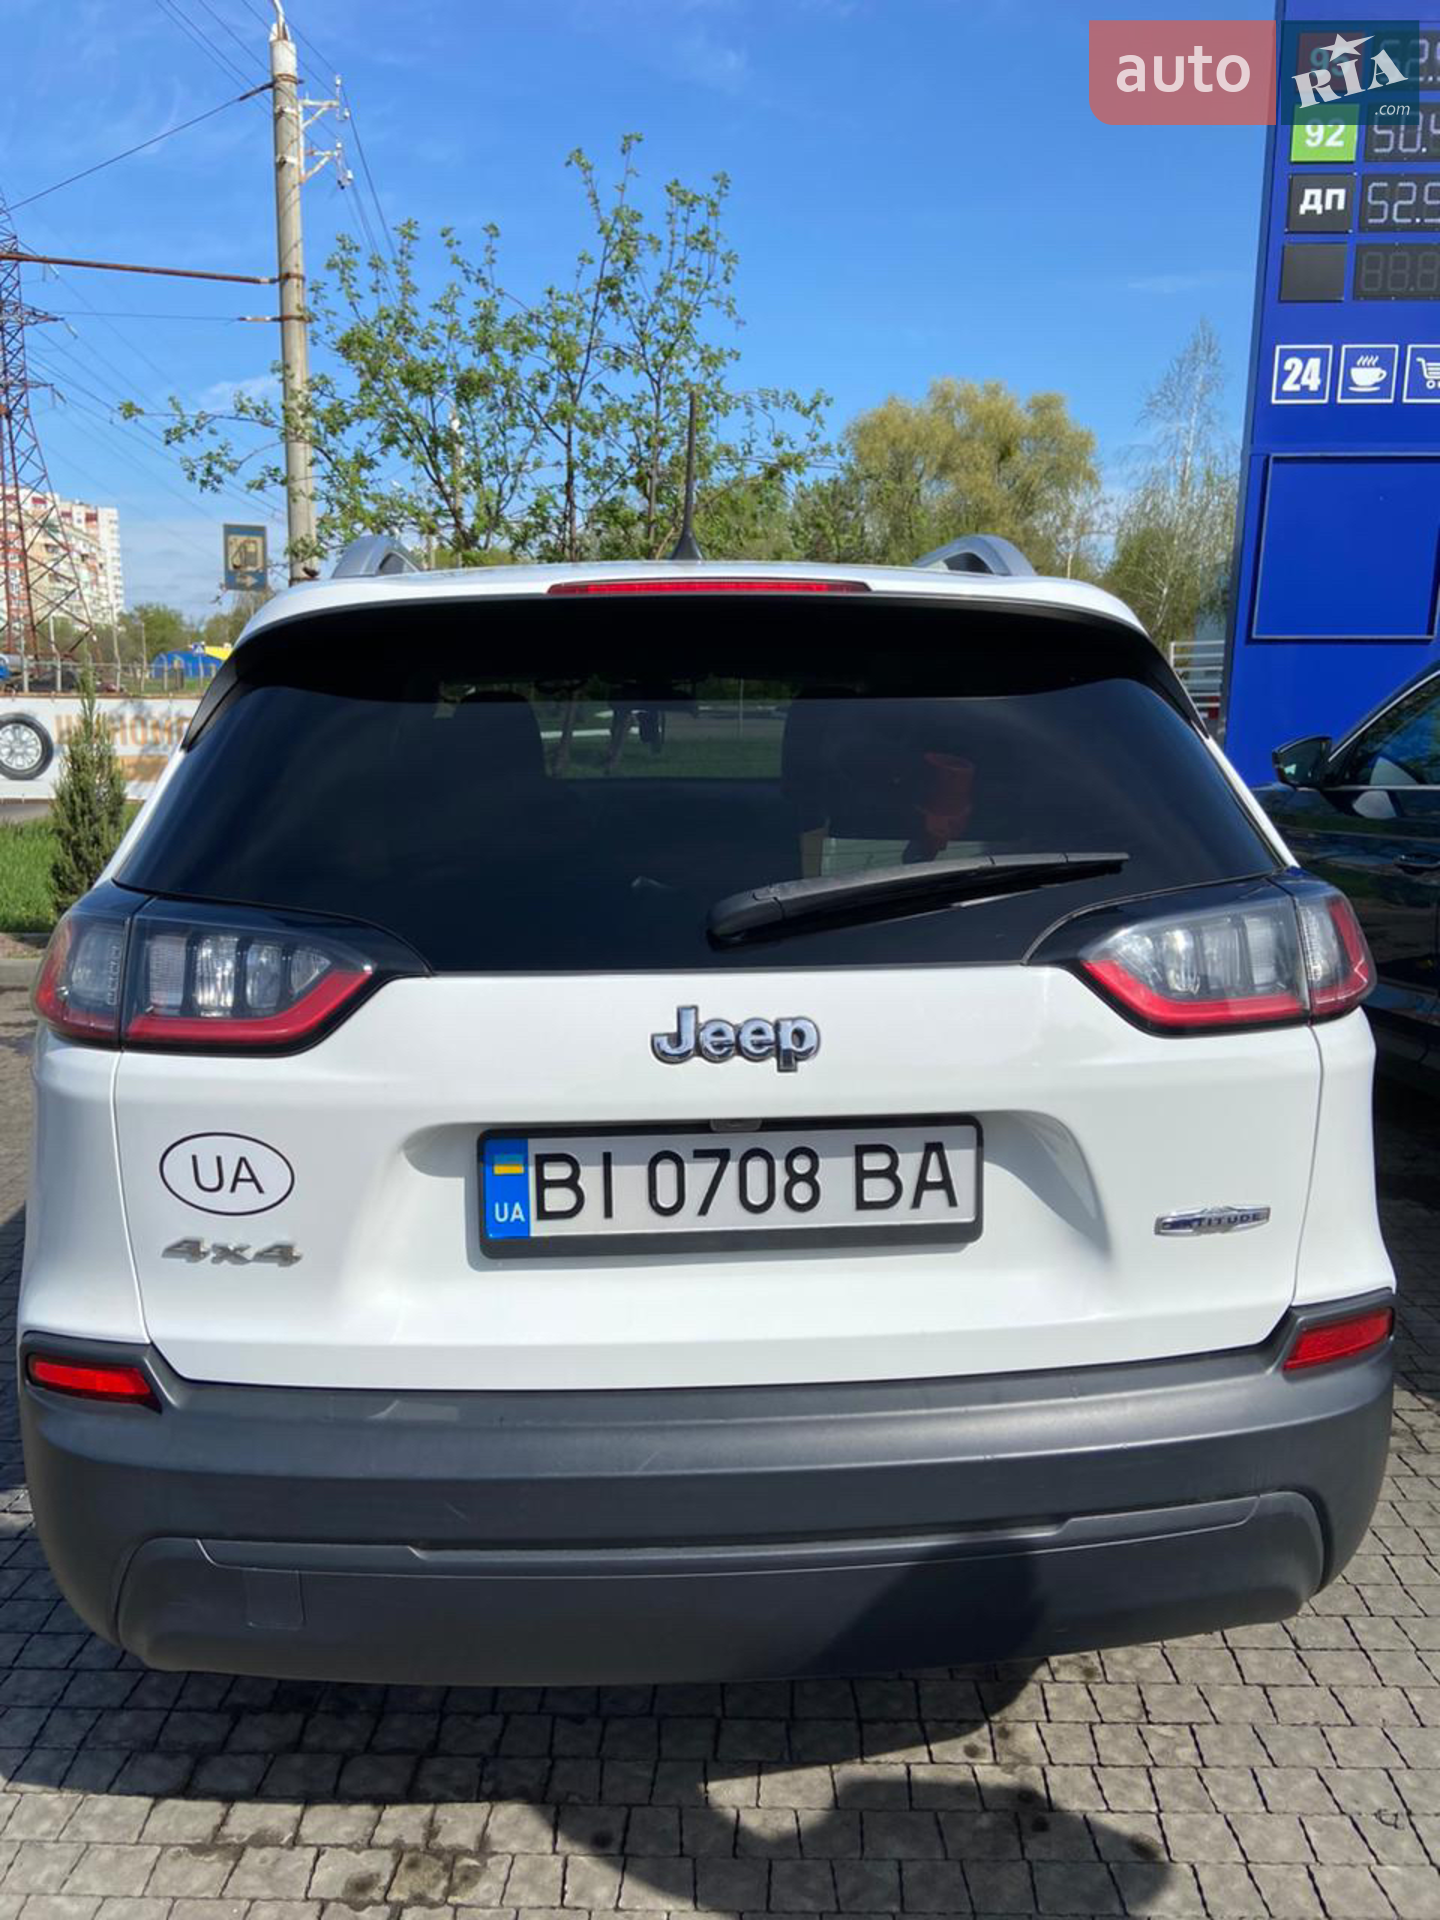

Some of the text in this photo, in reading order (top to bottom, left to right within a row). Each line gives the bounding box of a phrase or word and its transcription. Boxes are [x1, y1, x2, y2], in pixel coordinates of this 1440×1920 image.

[1304, 117, 1346, 148] 92
[1299, 188, 1346, 215] ДП
[1282, 356, 1321, 392] 24
[651, 1005, 821, 1073] Jeep
[191, 1153, 265, 1195] UA
[534, 1140, 960, 1221] BI 0708 BA
[494, 1201, 526, 1223] UA
